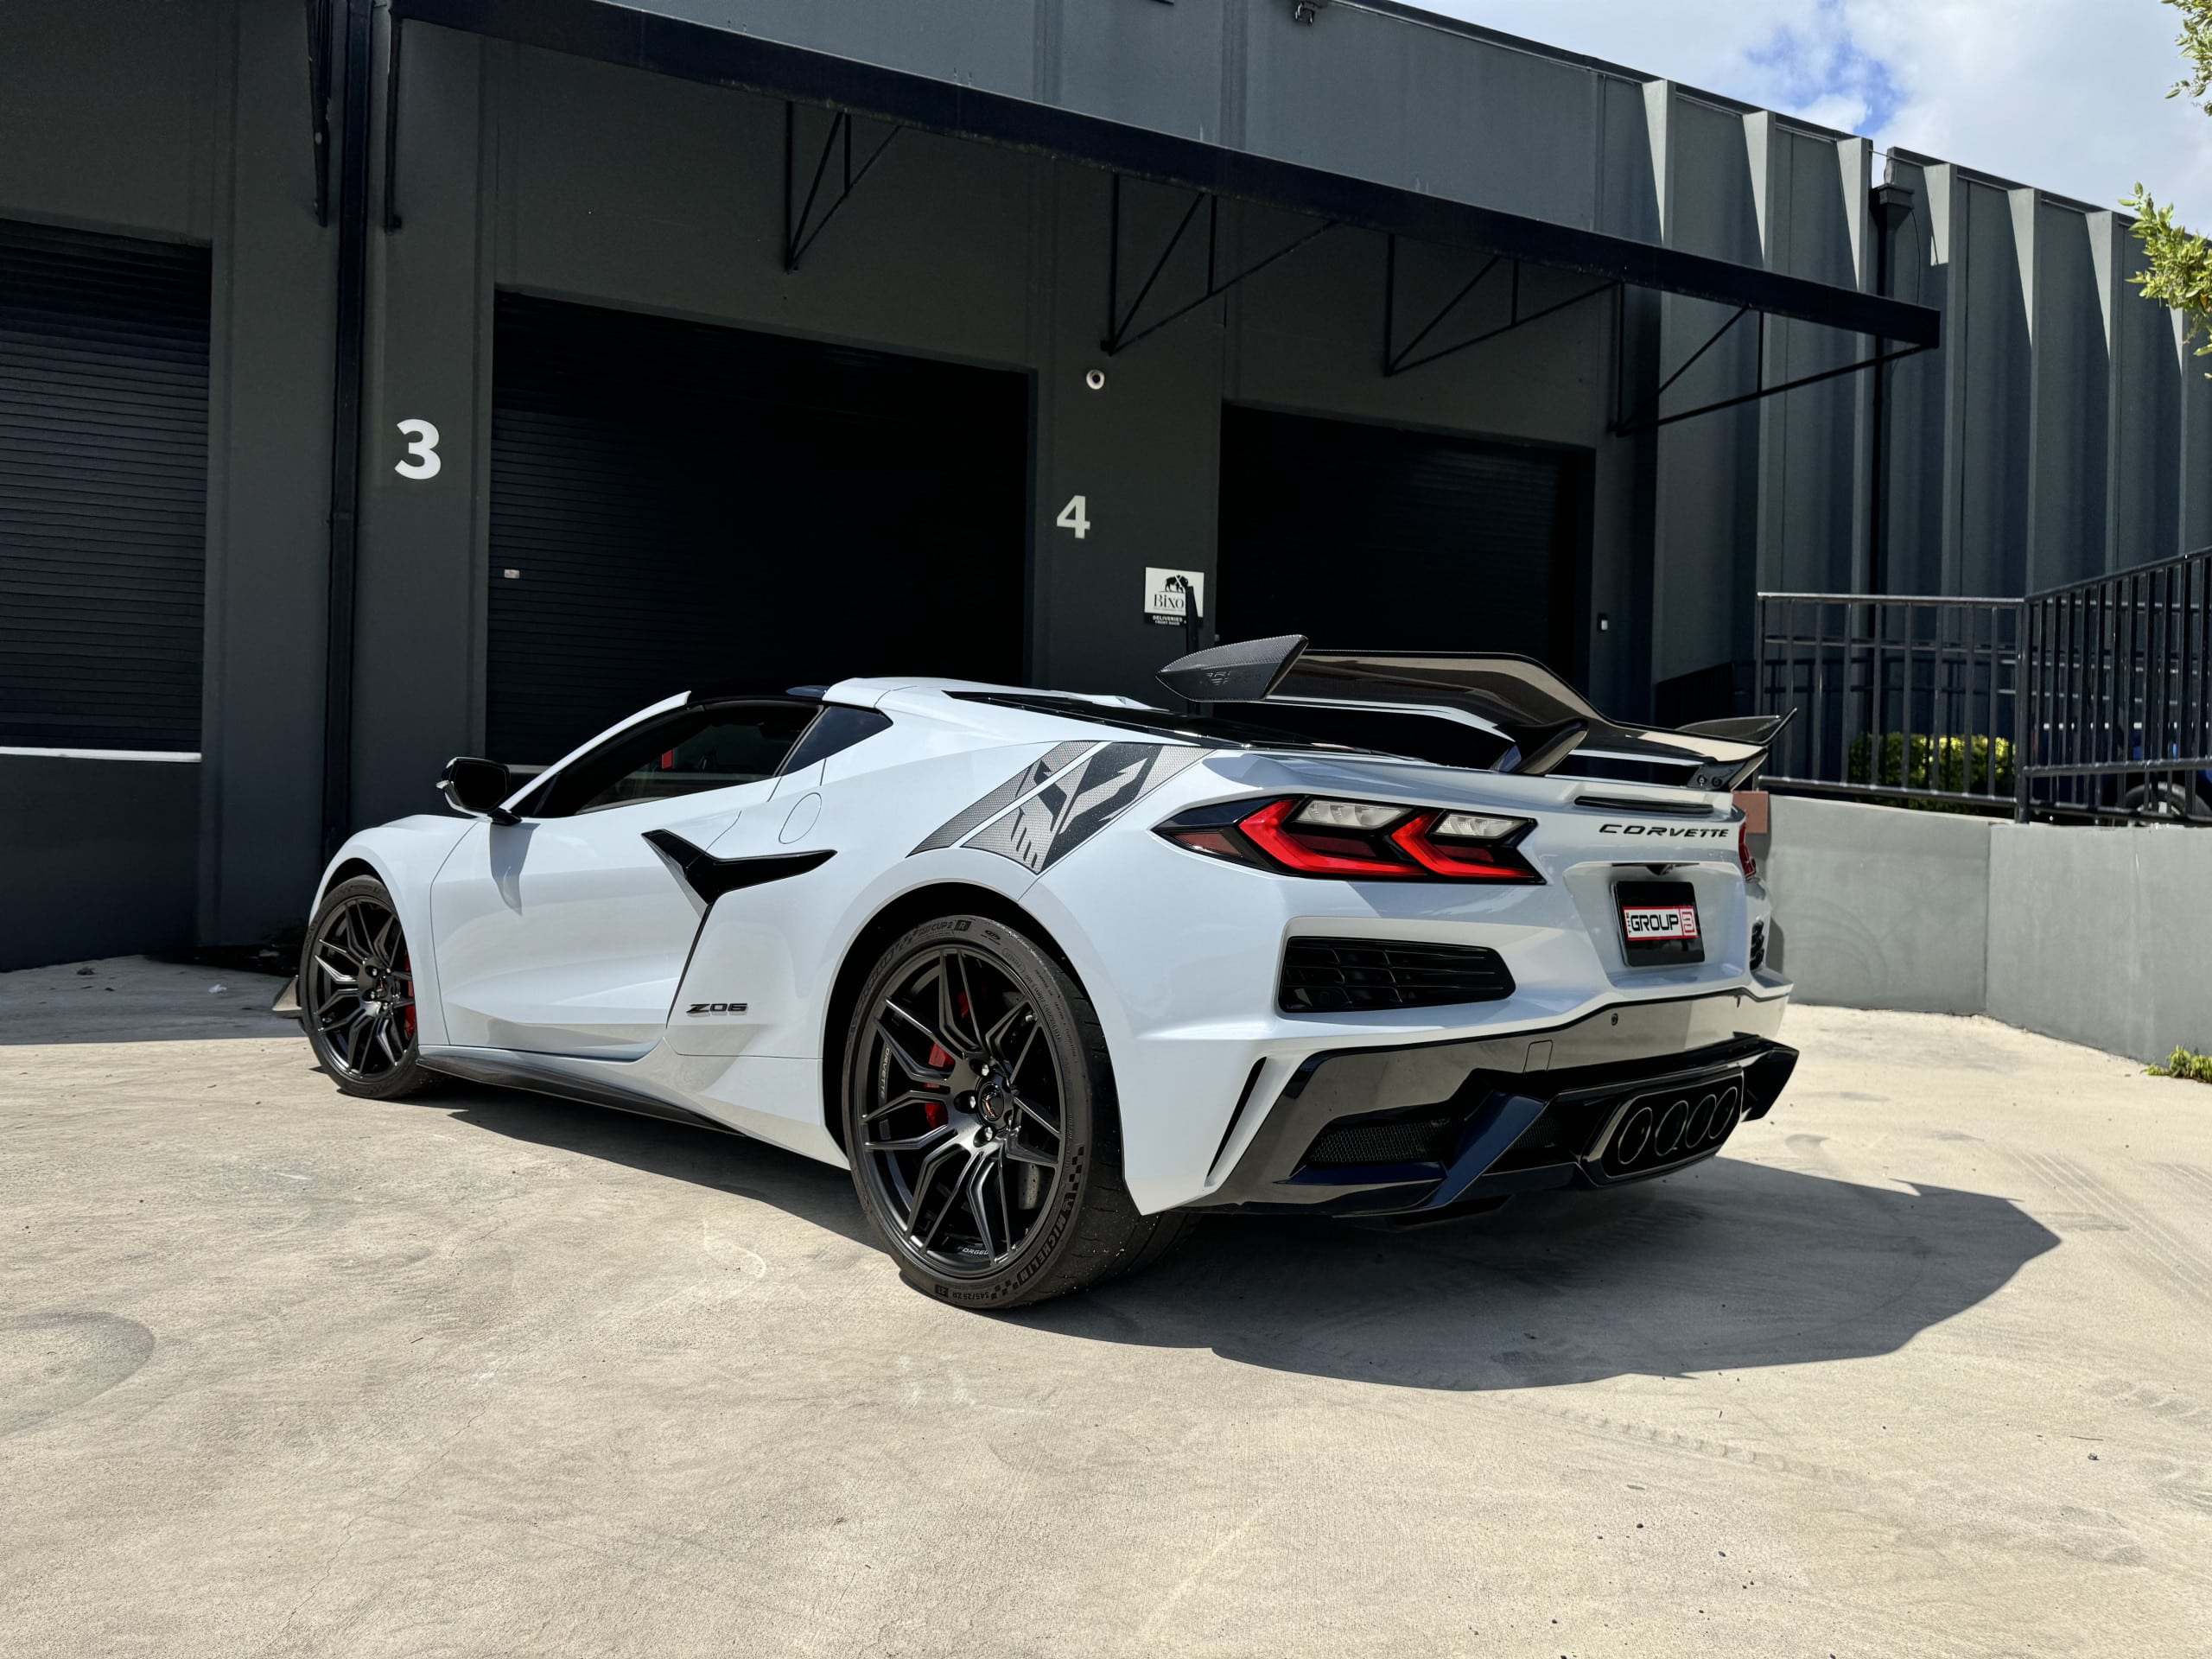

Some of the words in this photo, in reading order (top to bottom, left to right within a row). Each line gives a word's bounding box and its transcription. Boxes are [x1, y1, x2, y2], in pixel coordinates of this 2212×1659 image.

[395, 418, 442, 480] 3
[1057, 495, 1090, 539] 4
[1599, 823, 1729, 838] CORVETTE
[1630, 913, 1679, 932] GROUP
[686, 1002, 748, 1015] Z06
[880, 1046, 891, 1100] ORVETTE
[1019, 1213, 1067, 1282] MICHELIN
